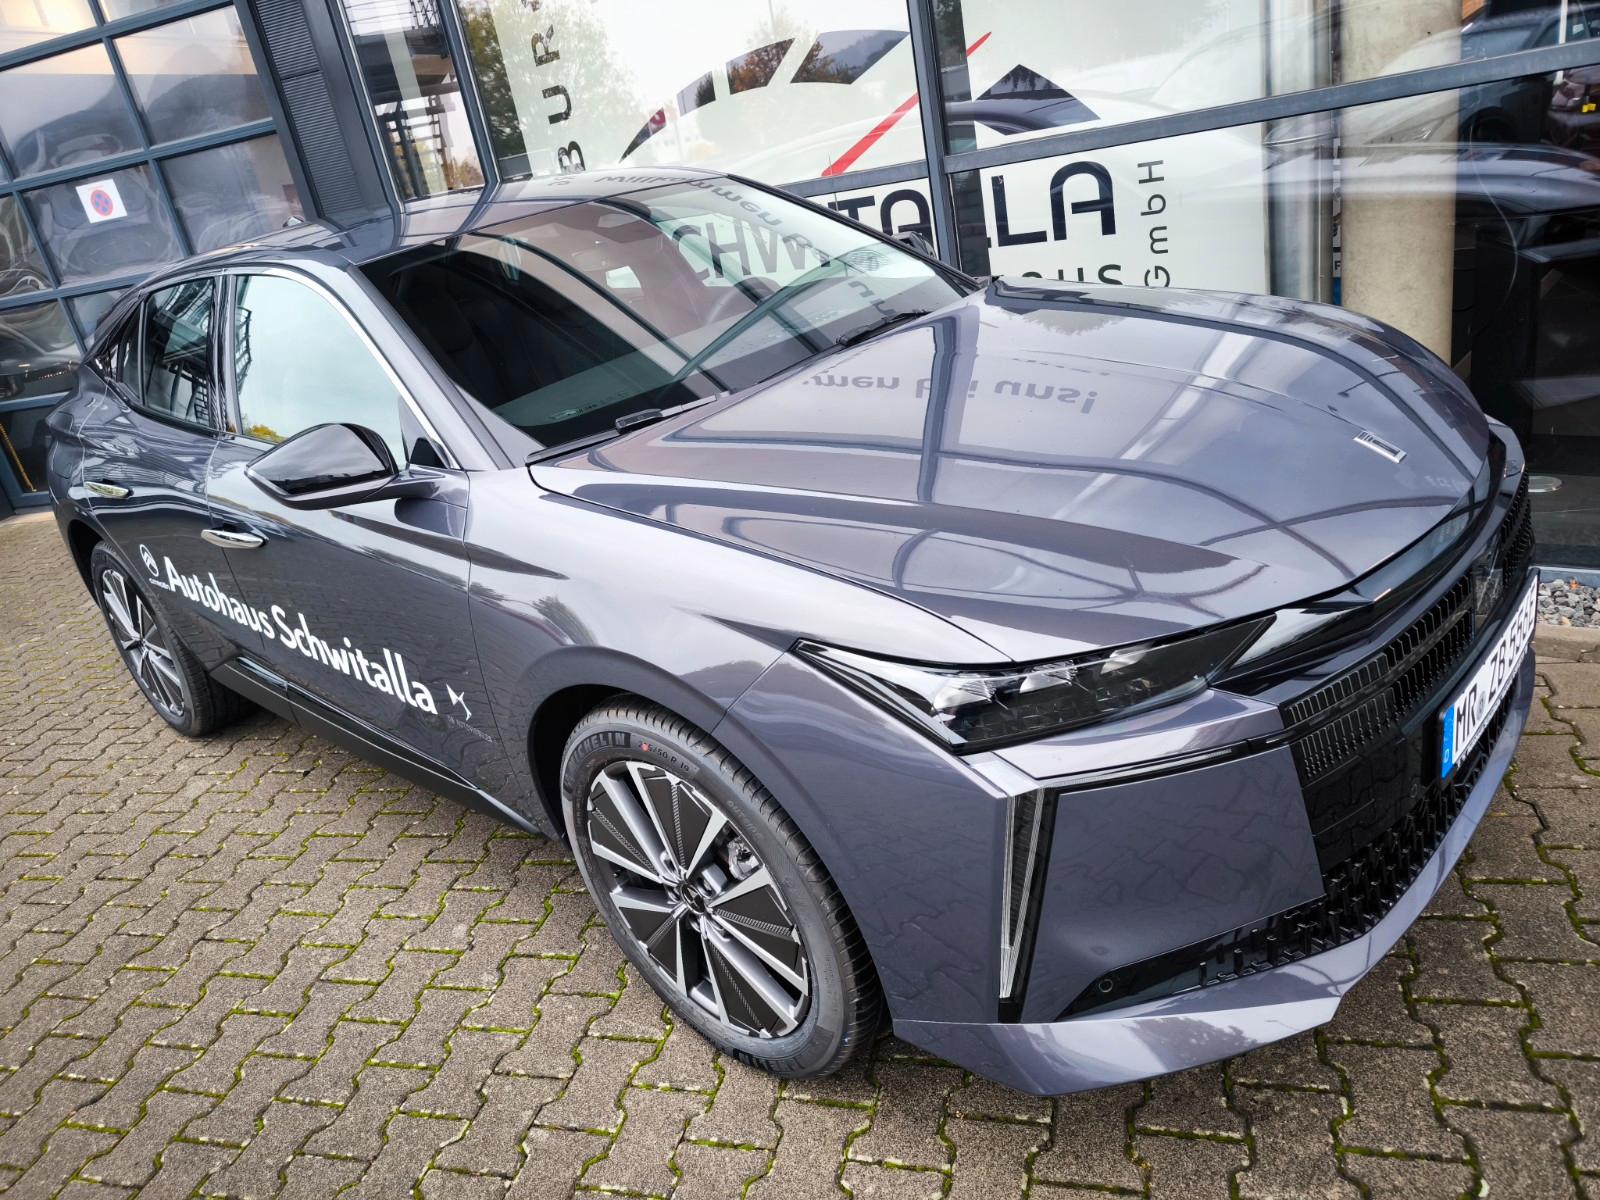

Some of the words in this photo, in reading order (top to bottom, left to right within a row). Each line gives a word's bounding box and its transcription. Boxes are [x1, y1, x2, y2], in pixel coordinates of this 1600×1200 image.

[1137, 160, 1171, 288] GmbH
[163, 555, 275, 640] Autohaus
[271, 604, 438, 715] Schwitalla
[1455, 683, 1478, 754] MR
